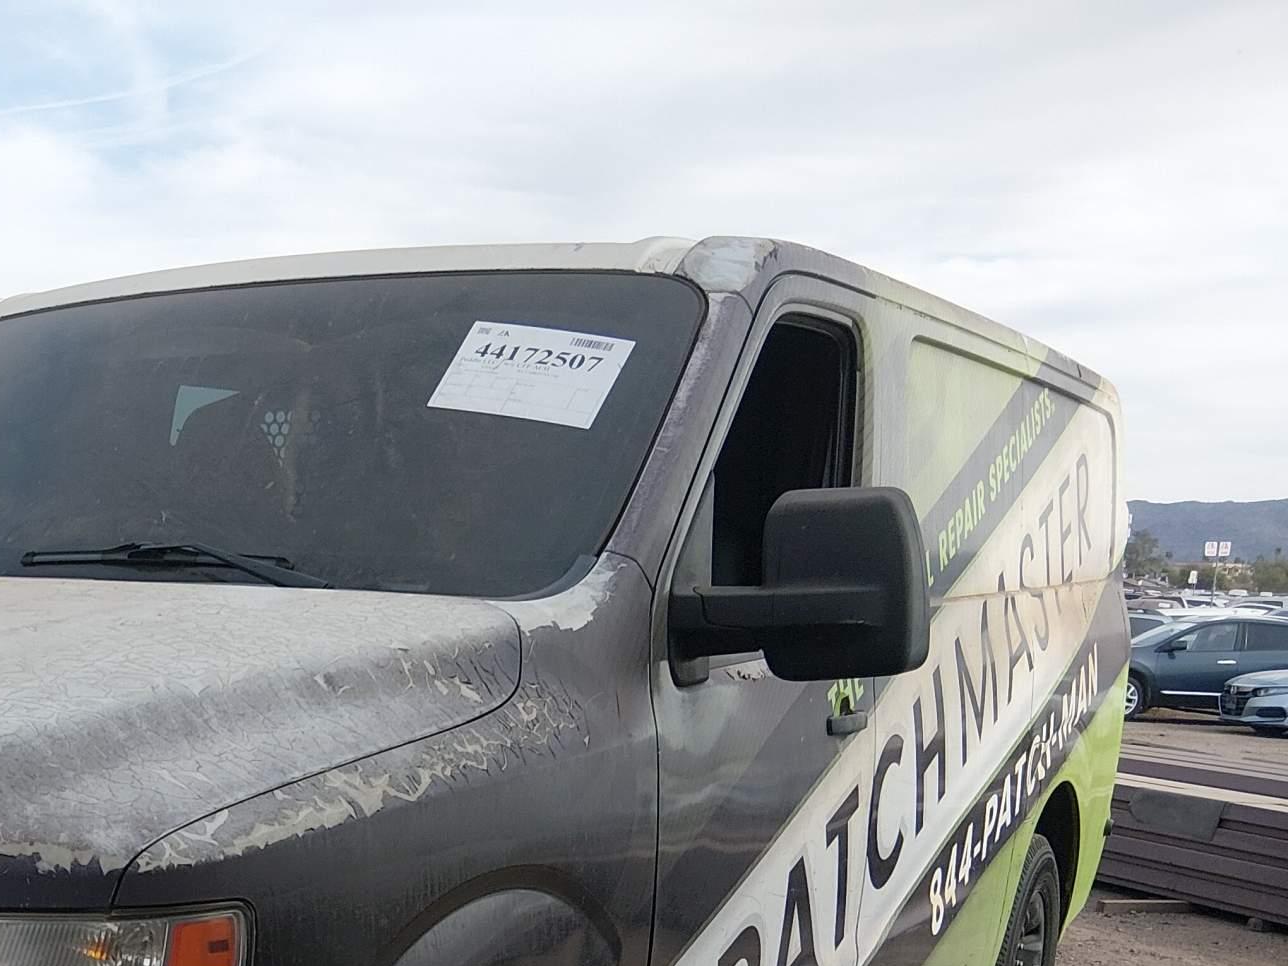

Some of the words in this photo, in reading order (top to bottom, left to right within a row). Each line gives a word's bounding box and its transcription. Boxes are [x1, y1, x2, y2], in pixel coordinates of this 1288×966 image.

[475, 342, 605, 373] 44172507
[939, 479, 985, 572] REPAIR
[929, 643, 1099, 936] 844-PATCH-MAN
